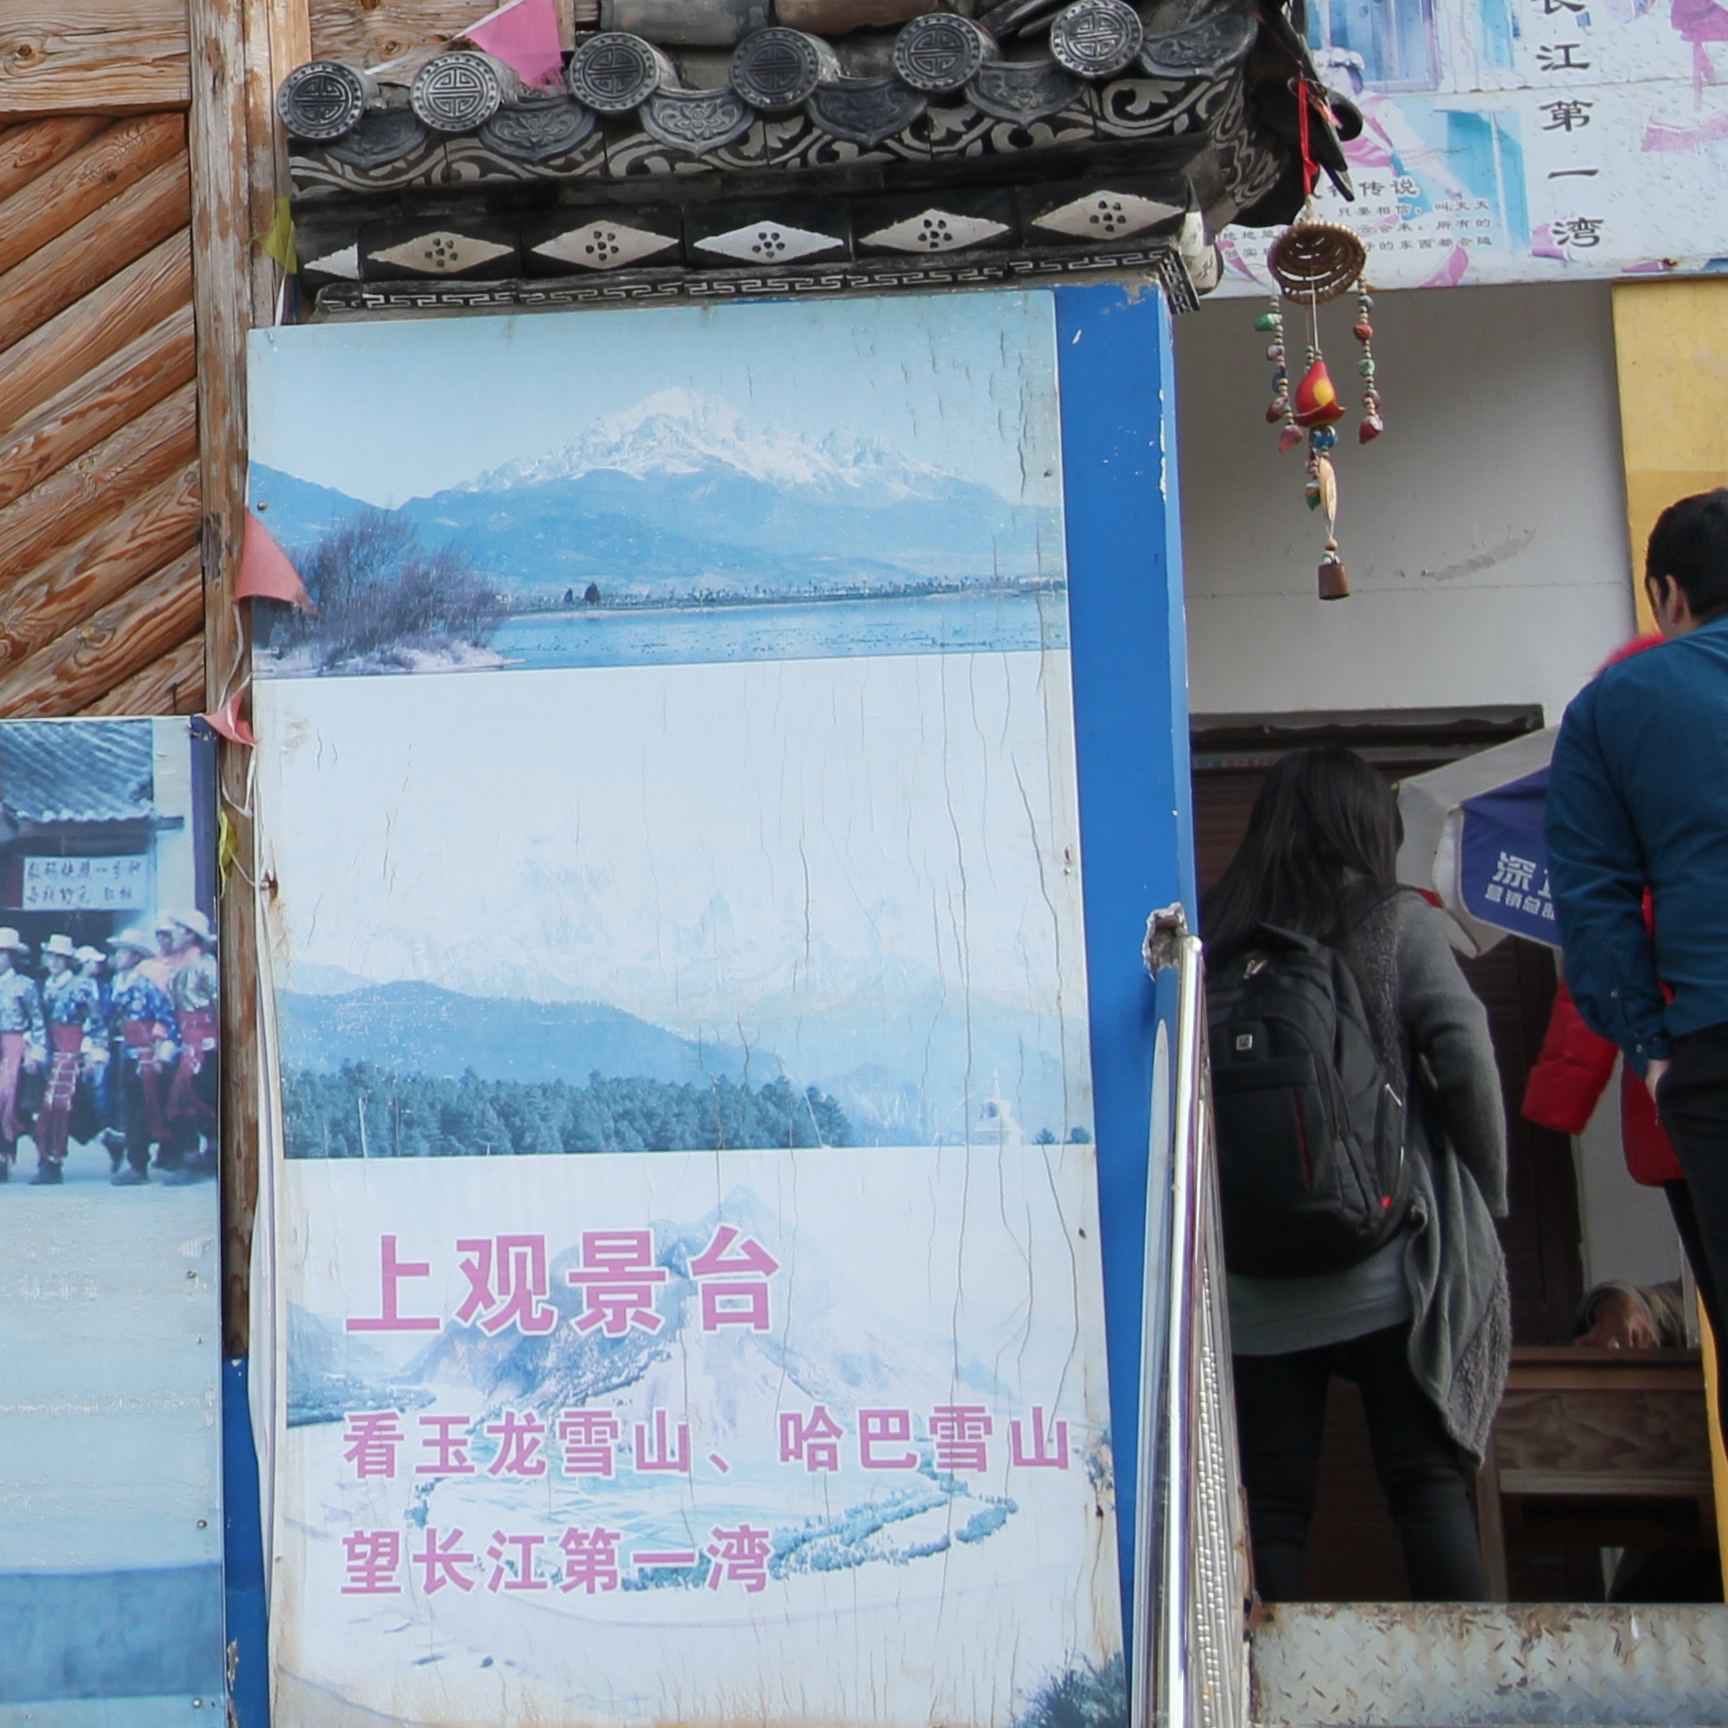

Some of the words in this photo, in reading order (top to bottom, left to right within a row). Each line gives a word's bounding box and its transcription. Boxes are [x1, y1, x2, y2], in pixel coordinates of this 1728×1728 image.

[344, 1224, 781, 1336] 上观景台
[340, 1524, 773, 1596] 望长江第一湾
